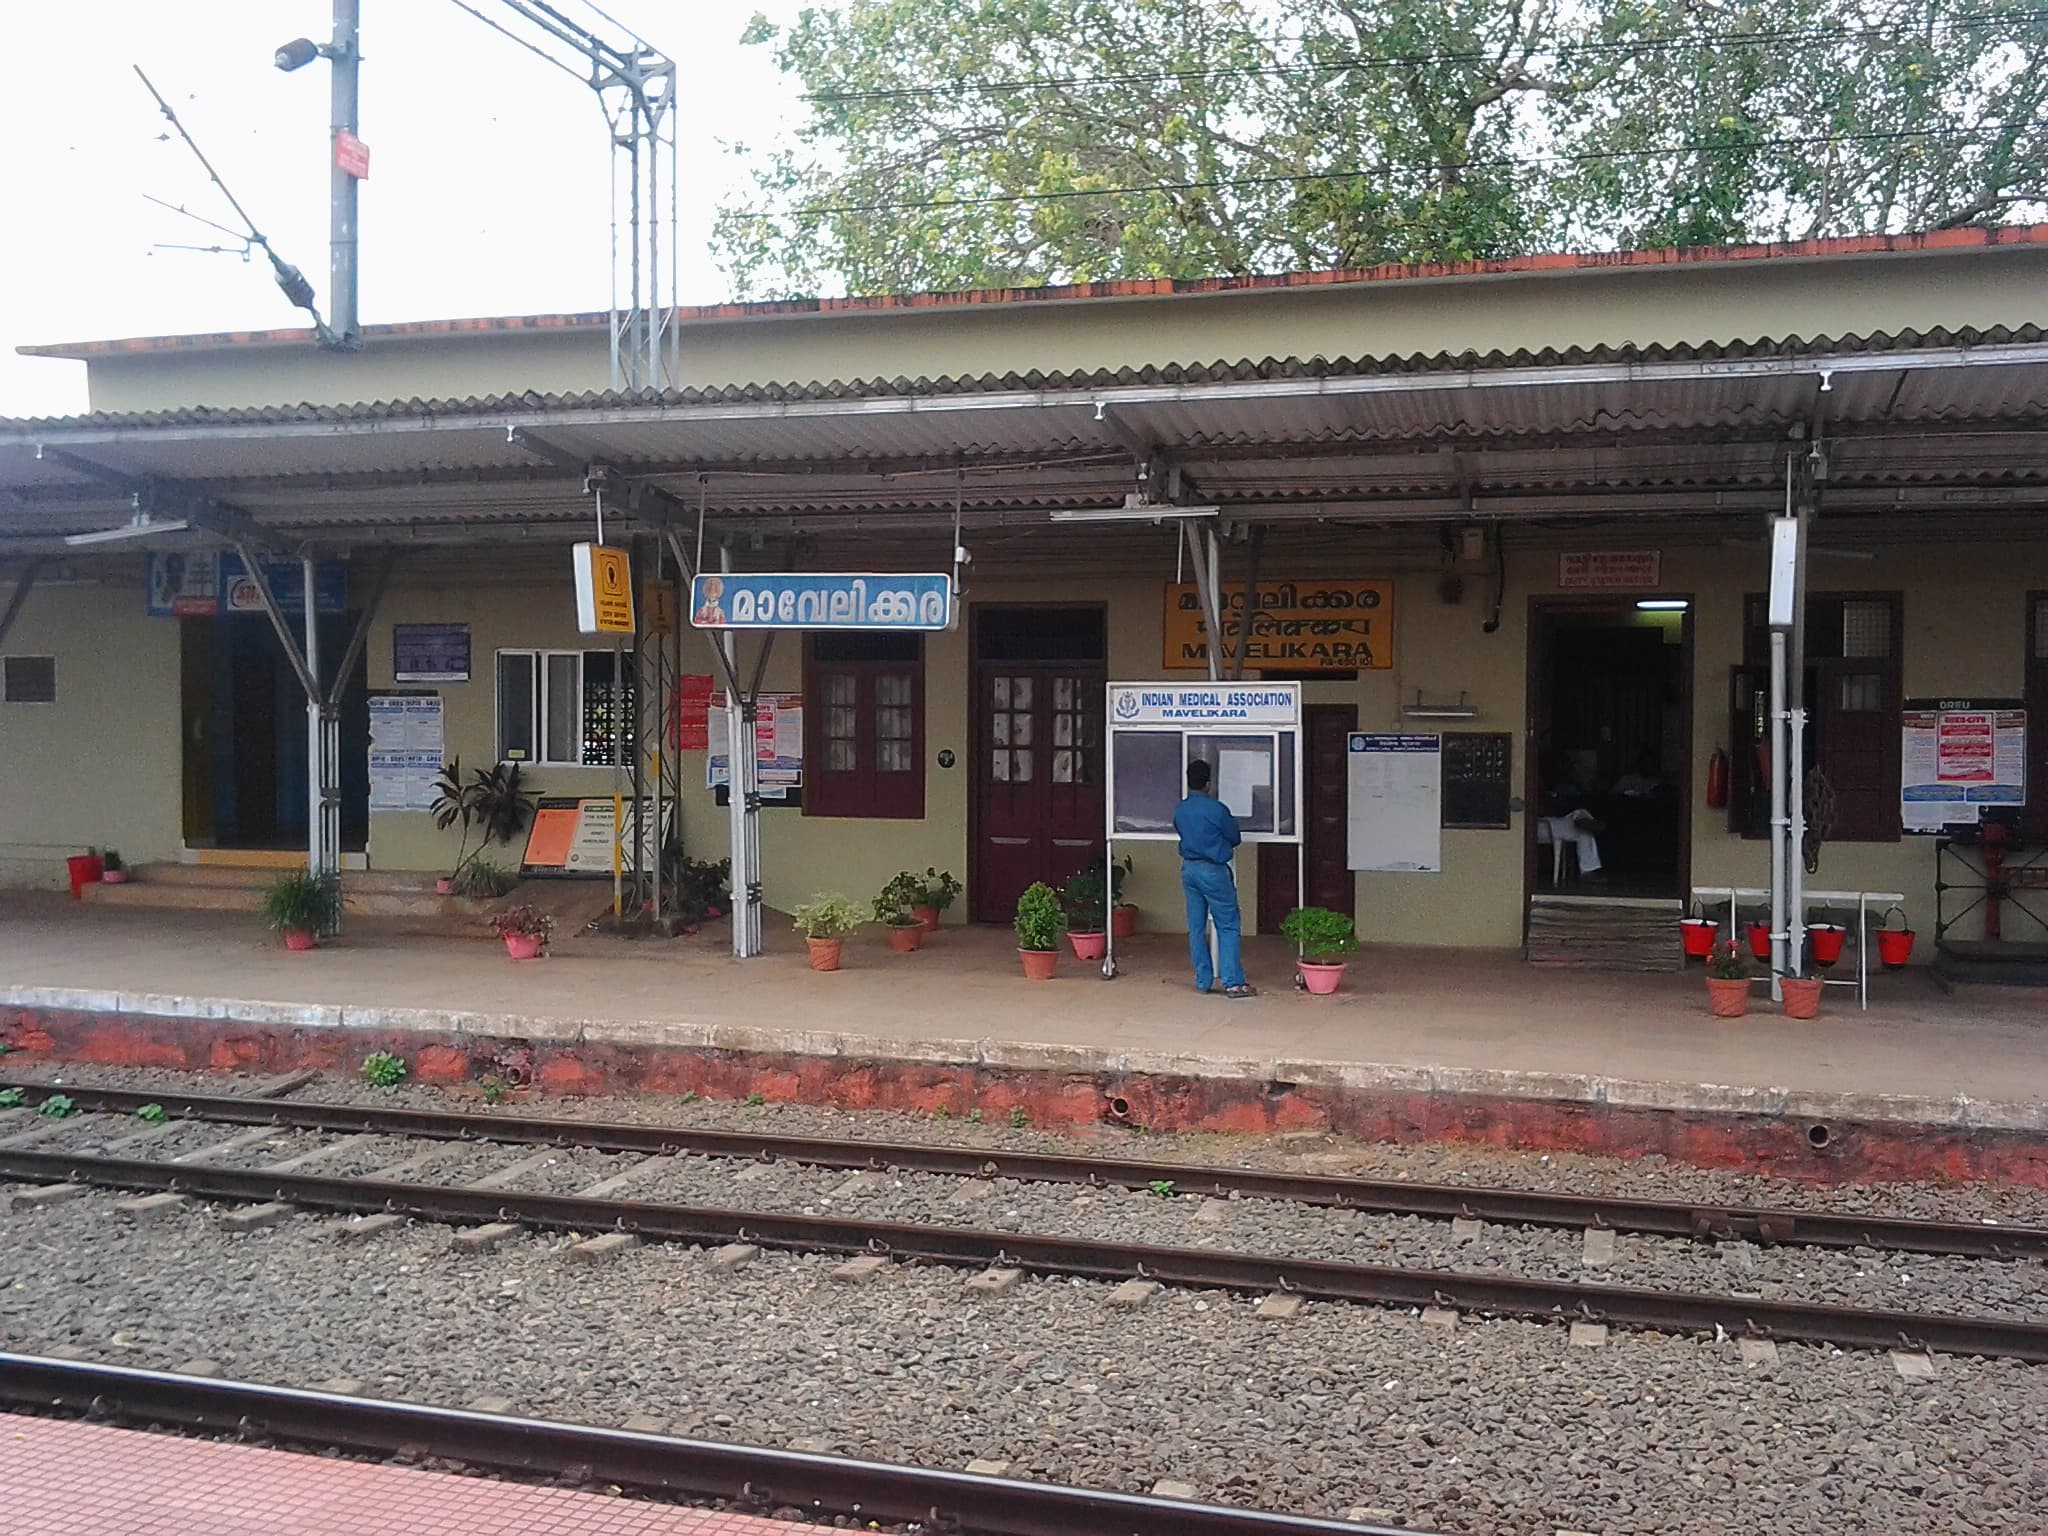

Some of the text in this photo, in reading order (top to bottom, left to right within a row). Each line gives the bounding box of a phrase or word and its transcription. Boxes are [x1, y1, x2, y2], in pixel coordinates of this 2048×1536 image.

[732, 579, 944, 624] മാവേലിക്കര
[1178, 583, 1381, 610] മവലിക്കര
[1141, 692, 1292, 707] INDIAN MEDICAL ASSOCIATION
[1940, 701, 1970, 709] DREU
[1162, 709, 1247, 718] MAVELIKARA
